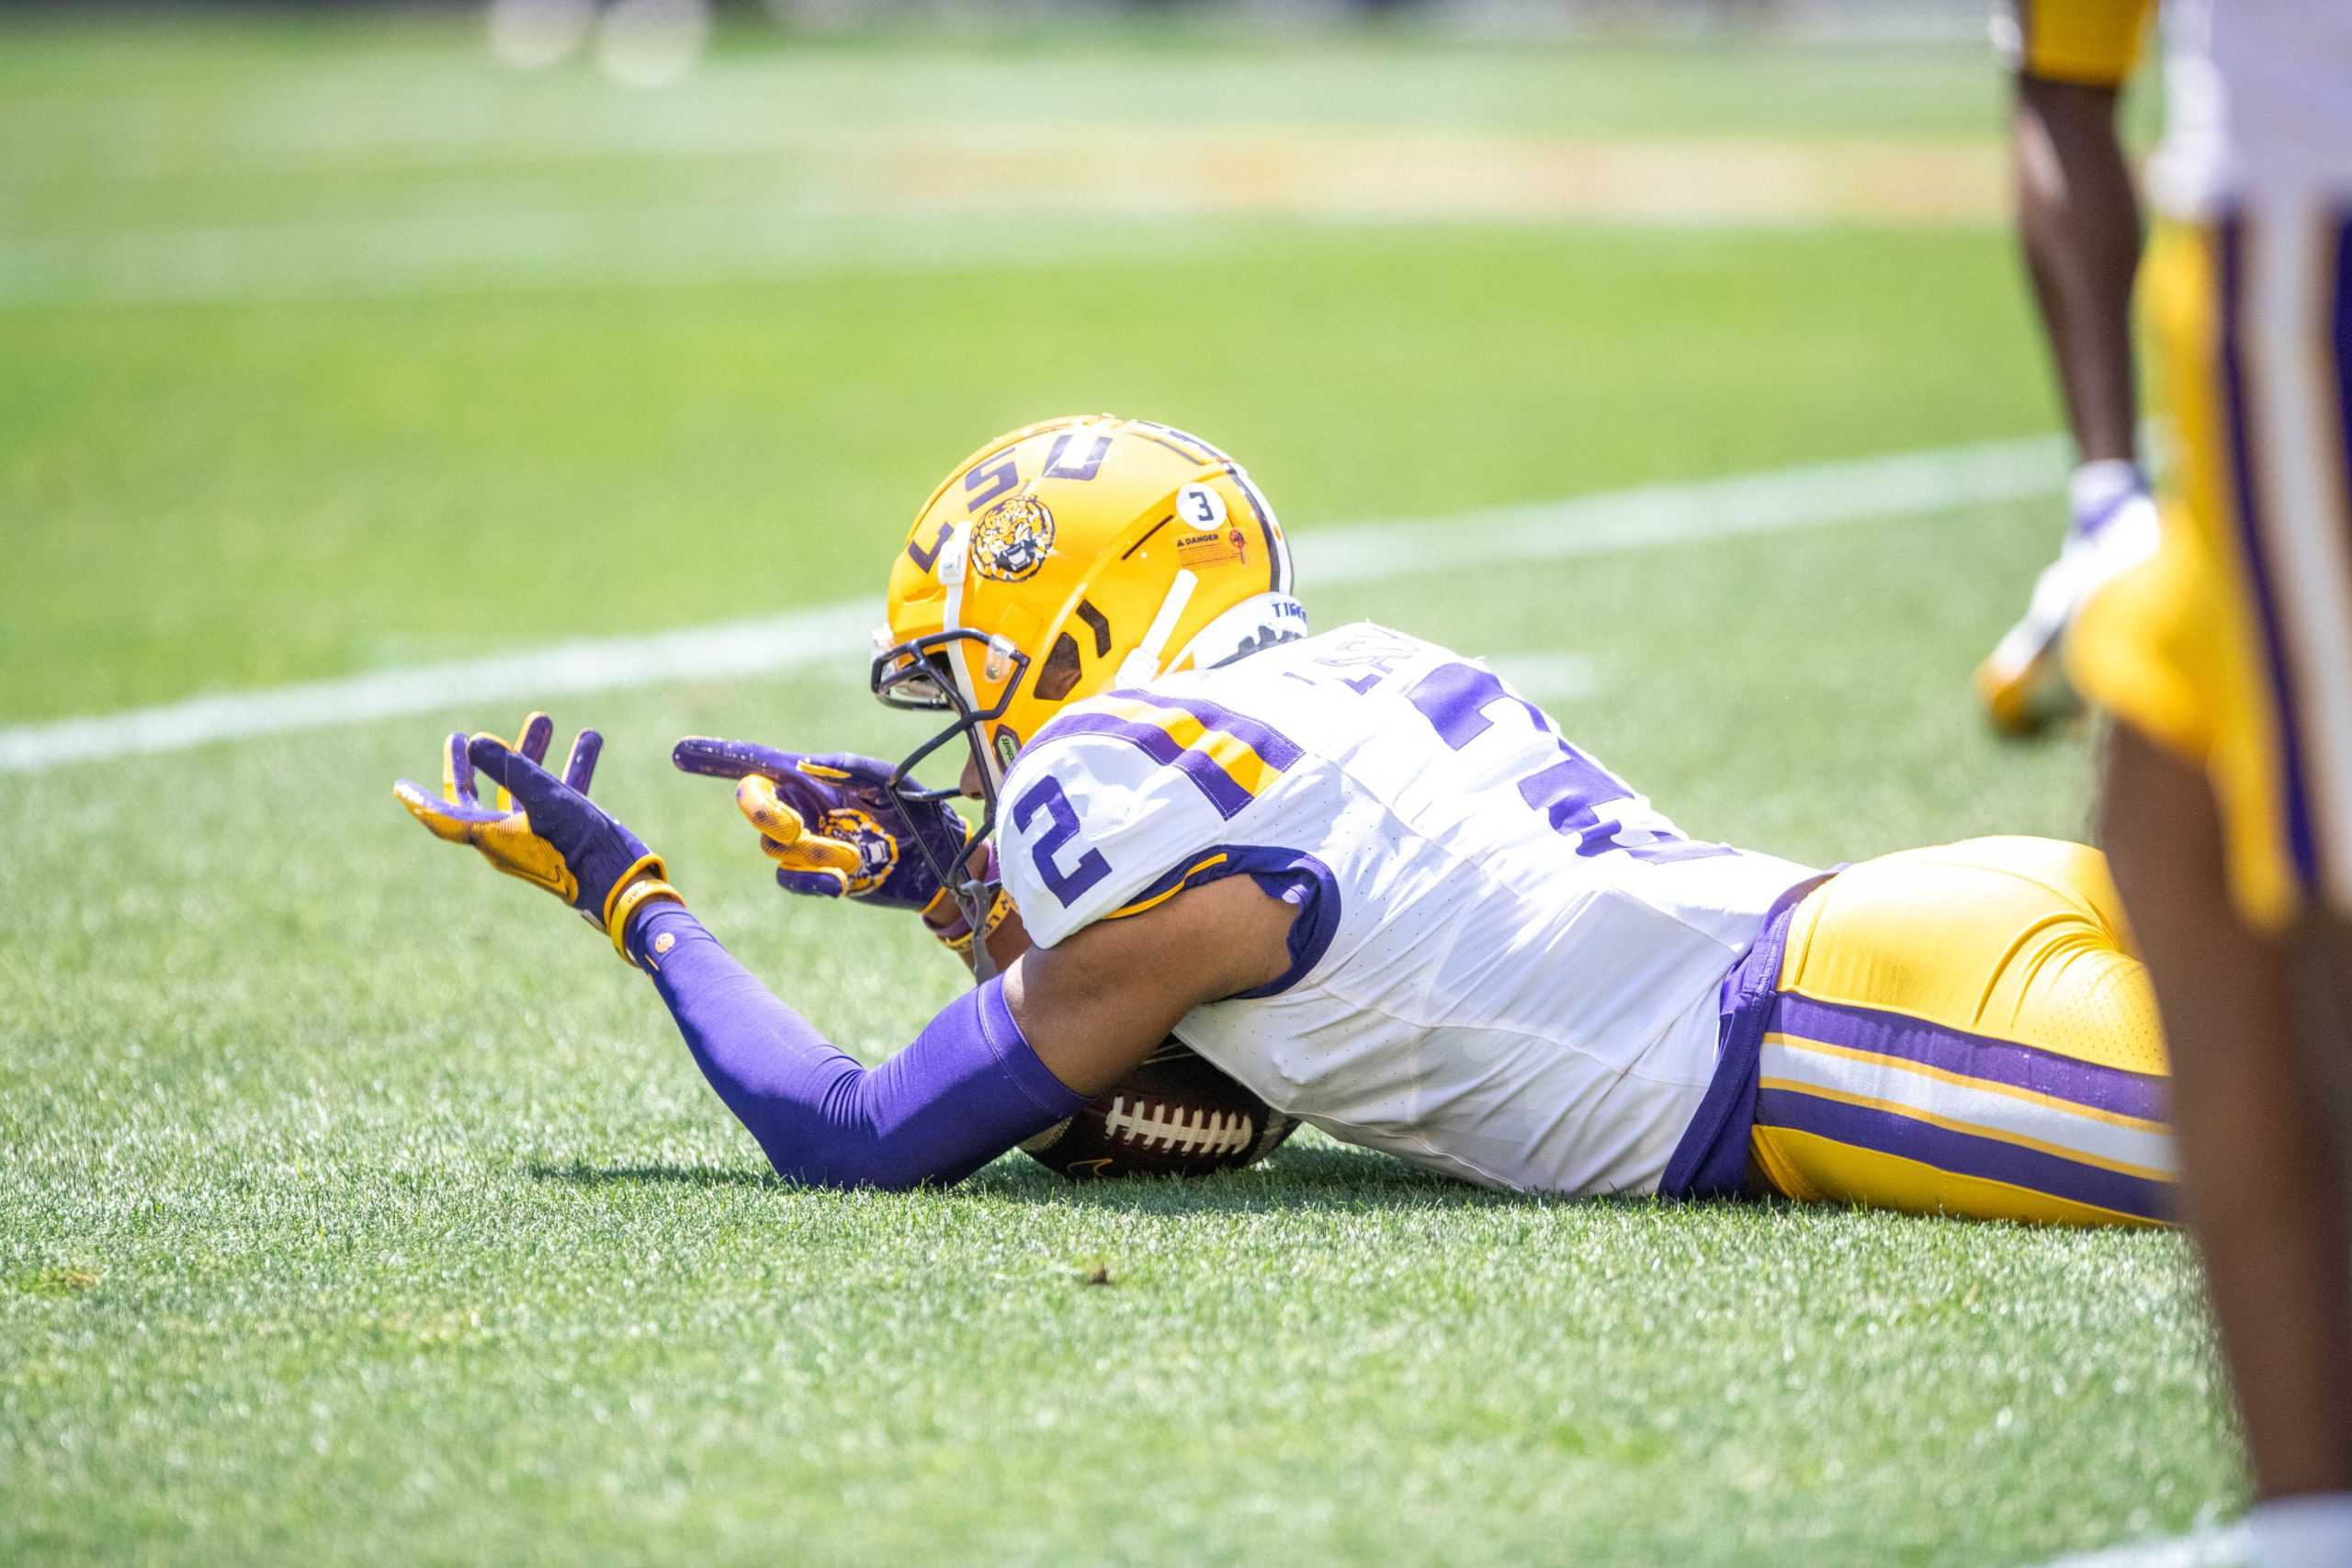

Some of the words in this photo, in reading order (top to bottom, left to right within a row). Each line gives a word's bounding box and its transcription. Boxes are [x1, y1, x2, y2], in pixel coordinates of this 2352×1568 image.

[908, 434, 1114, 574] LSU
[1188, 491, 1215, 522] 3
[1185, 534, 1219, 545] DANGER
[1001, 738, 1015, 761] chutt
[1012, 774, 1113, 908] 2
